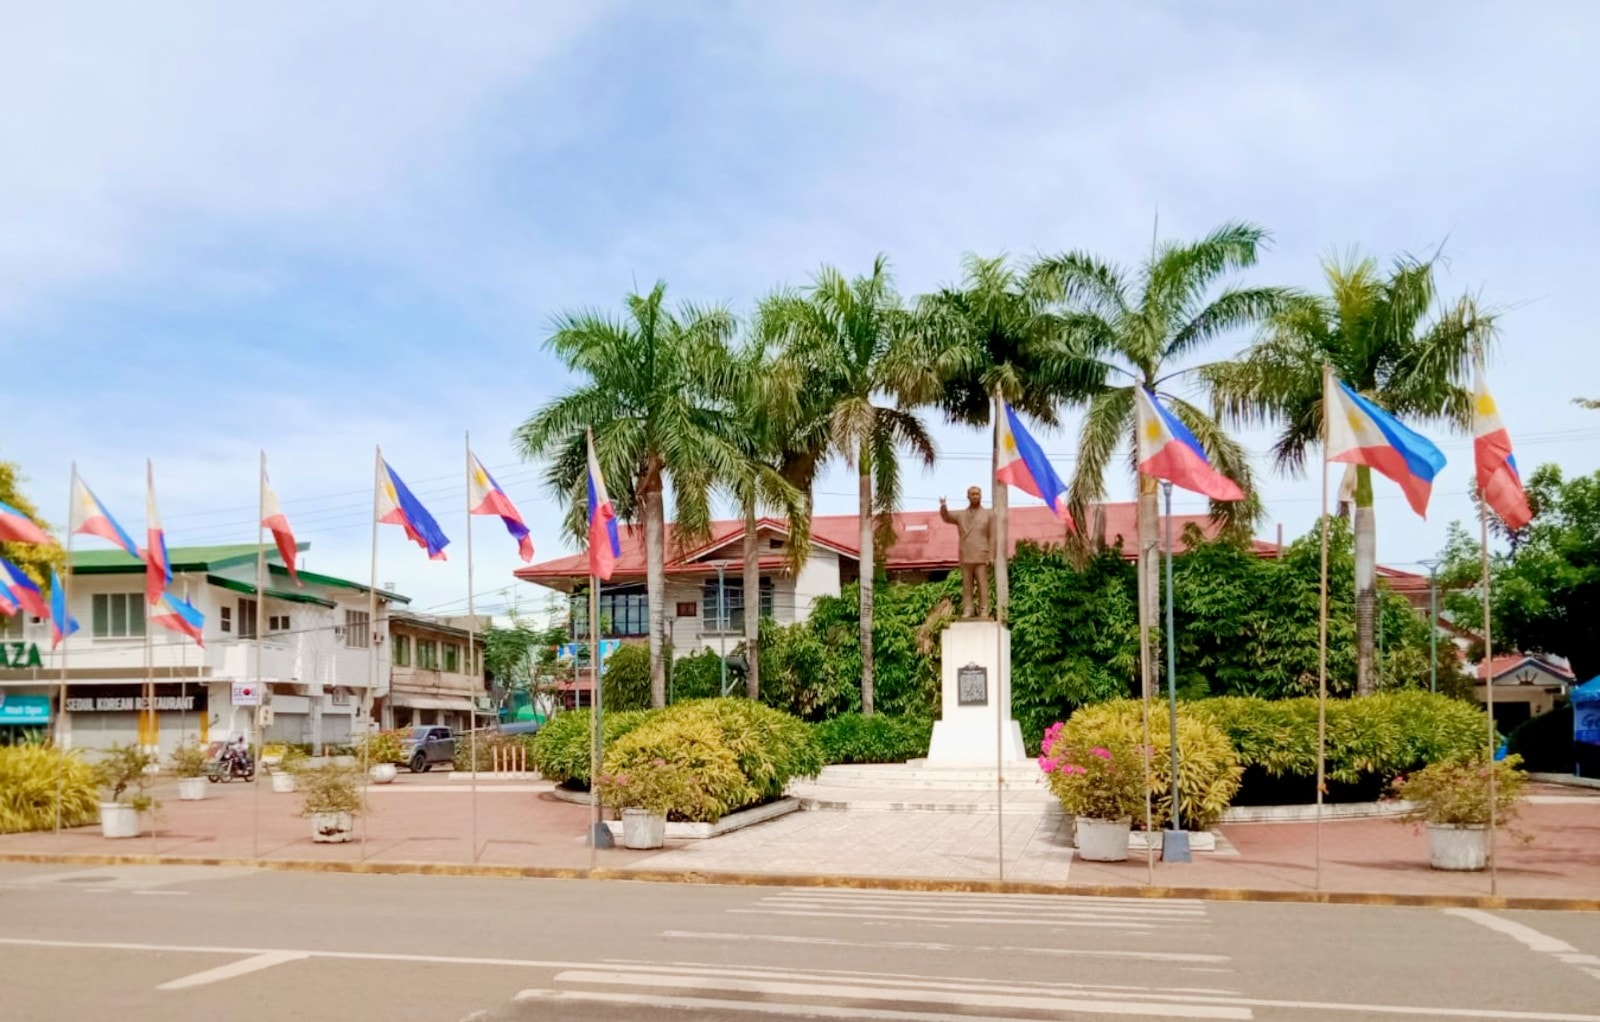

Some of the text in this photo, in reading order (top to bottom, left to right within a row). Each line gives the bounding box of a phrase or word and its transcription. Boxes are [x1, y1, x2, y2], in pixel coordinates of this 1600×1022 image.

[66, 696, 195, 711] SEOUL KOREAN RESTAURANT
